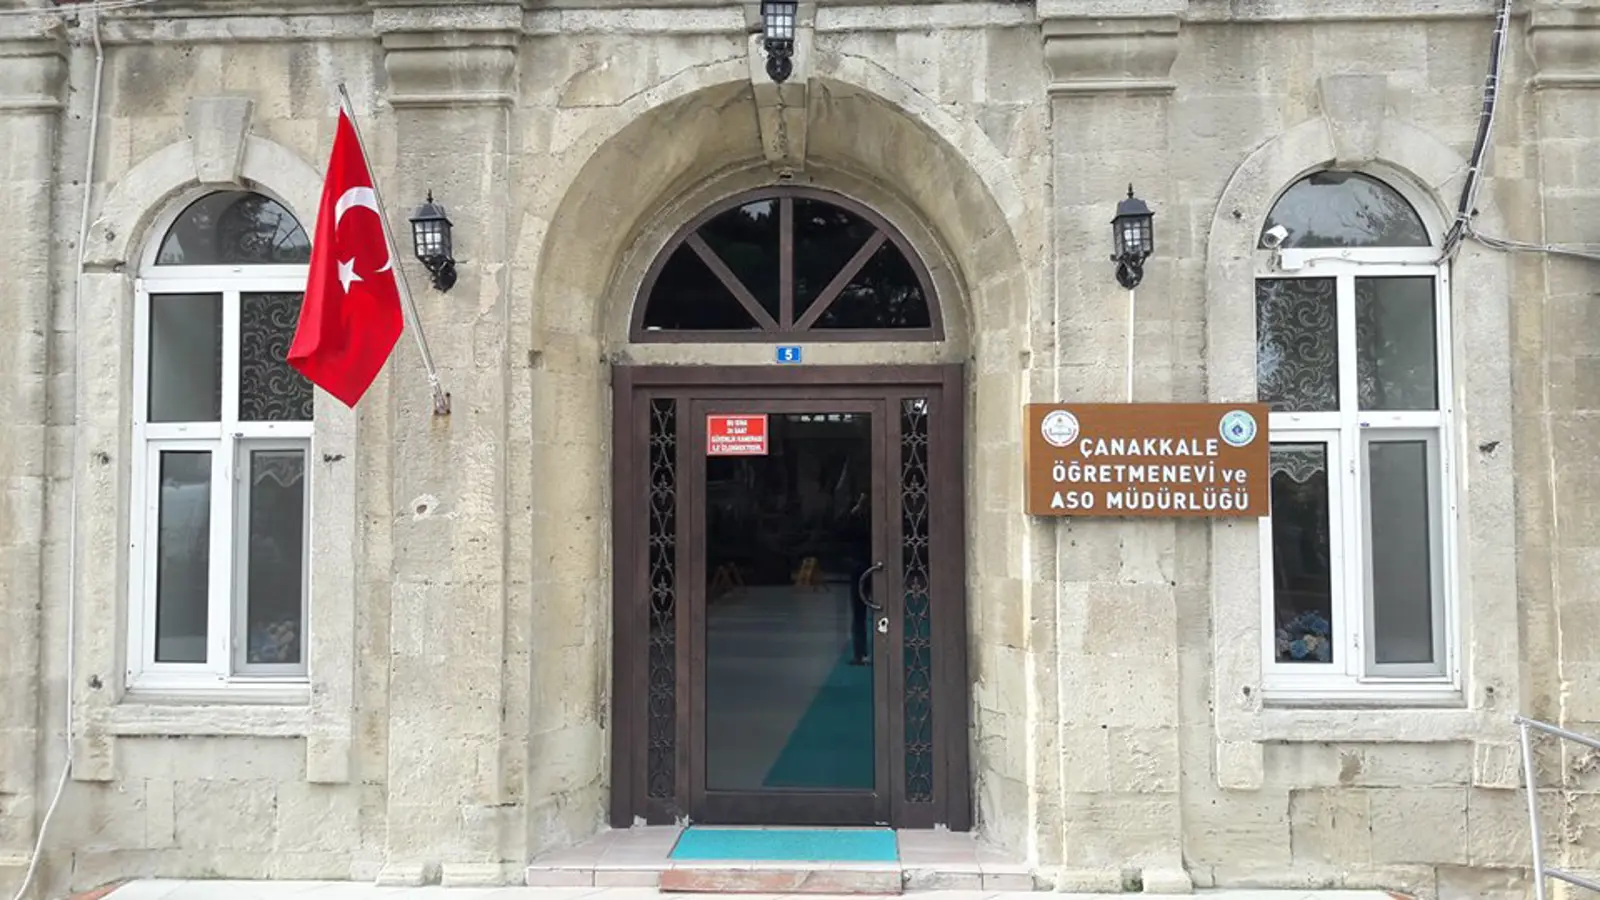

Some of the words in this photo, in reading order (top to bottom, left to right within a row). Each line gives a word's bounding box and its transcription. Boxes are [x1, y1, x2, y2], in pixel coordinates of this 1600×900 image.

[784, 348, 793, 360] 5
[1079, 438, 1218, 458] ÇANAKKALE
[1052, 460, 1215, 482] ÖĞRETMENEVİ
[1221, 468, 1247, 484] ve
[1050, 491, 1094, 509] ASO
[1107, 487, 1249, 509] MÜDÜRLÜĞÜ
